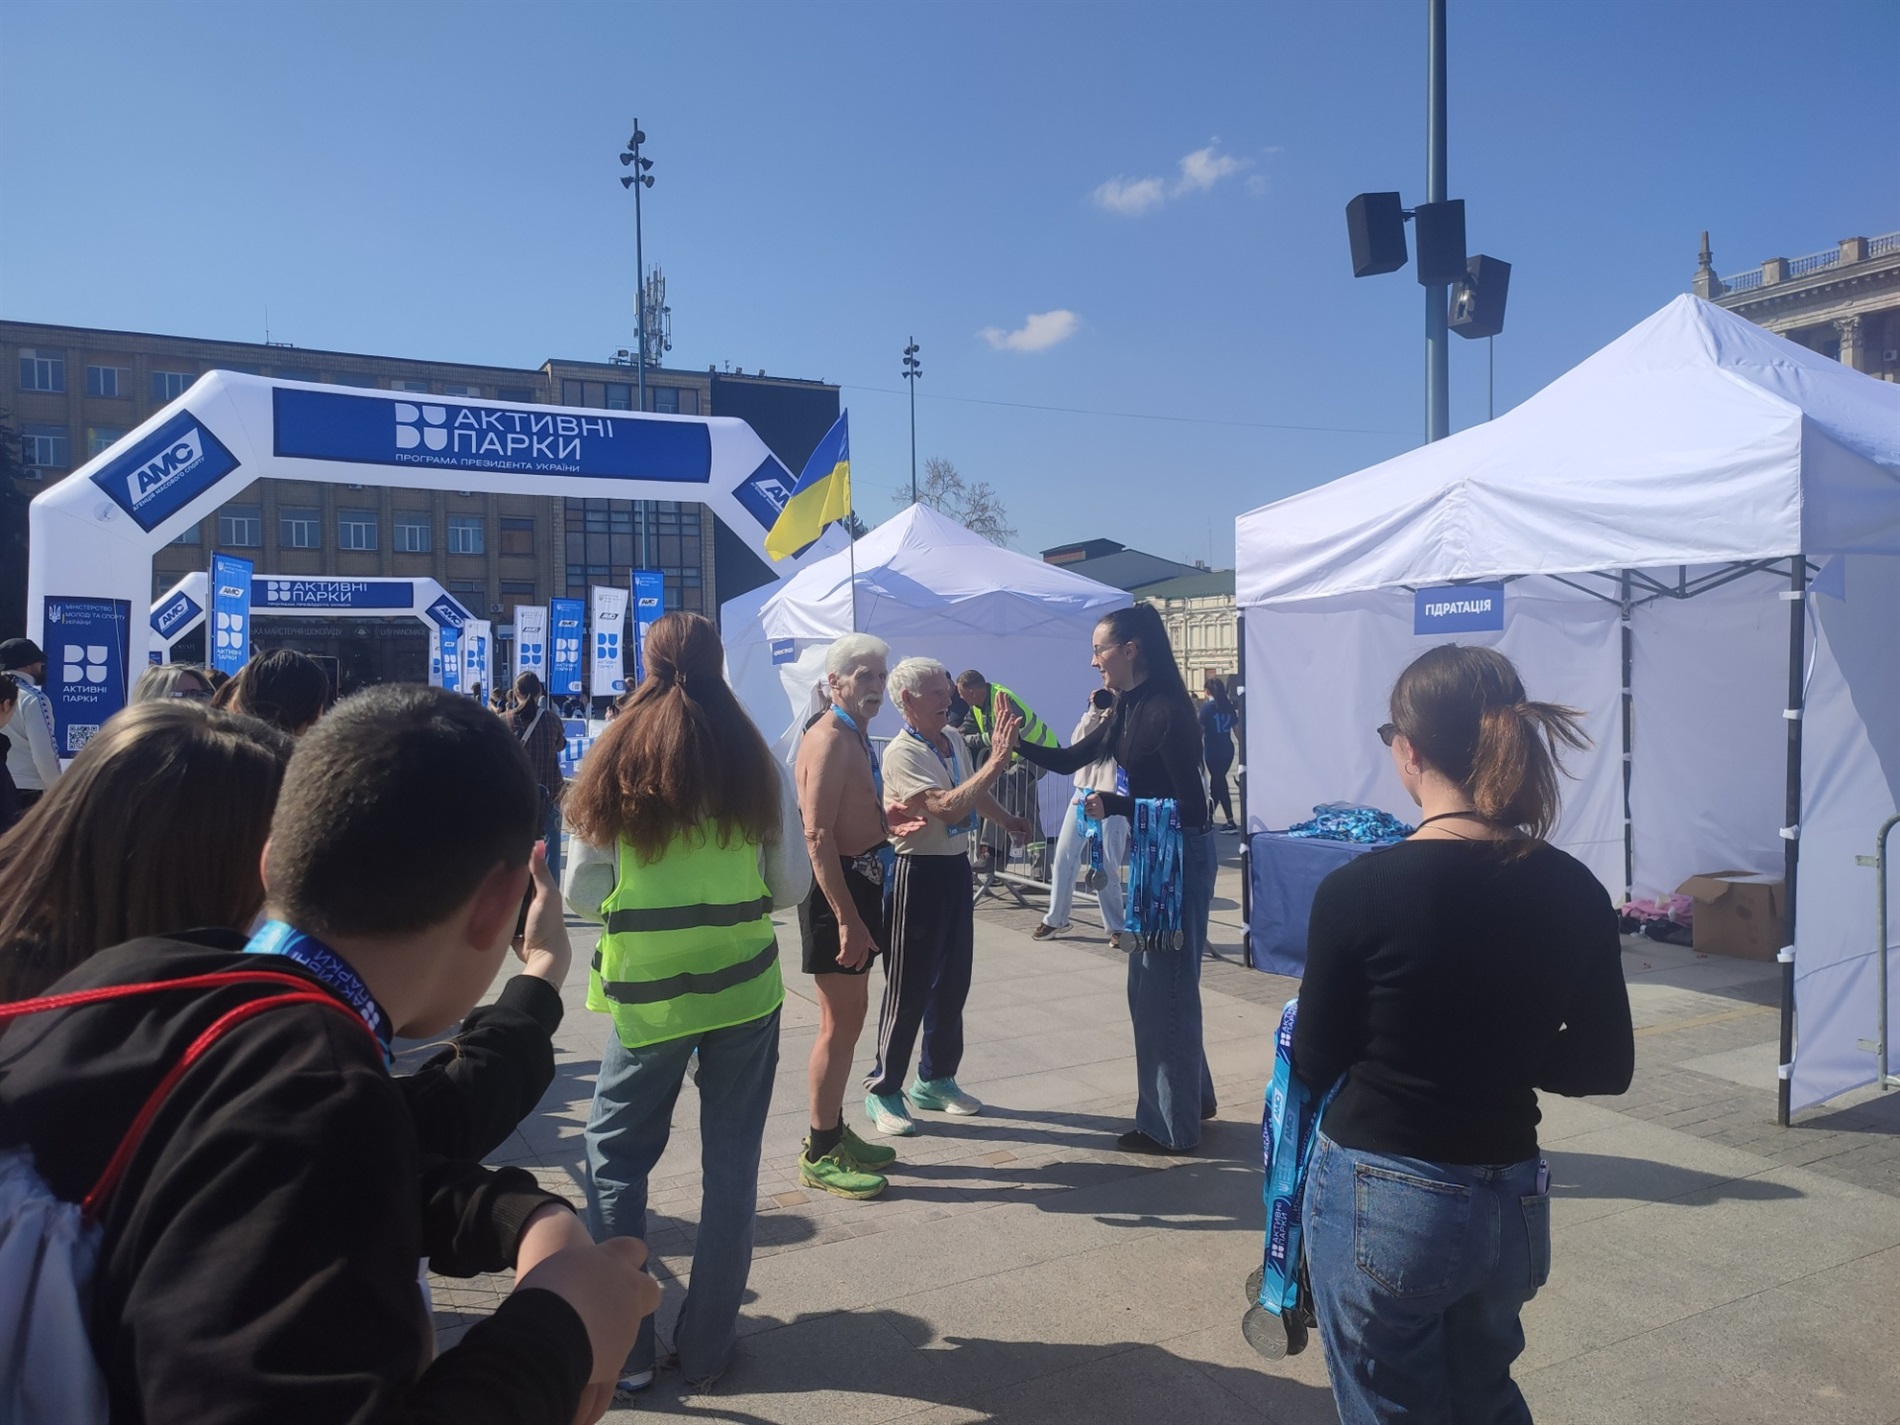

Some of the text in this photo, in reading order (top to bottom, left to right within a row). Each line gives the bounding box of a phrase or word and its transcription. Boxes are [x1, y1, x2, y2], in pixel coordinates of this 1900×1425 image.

[454, 408, 614, 438] АКТИВНІ
[454, 429, 581, 460] ПАРКИ
[395, 453, 580, 472] ПРОГРАМА ПРЕЗИДЕНТА УКРАЇНИ
[155, 472, 185, 495] МАСОВОГО
[184, 456, 205, 474] СПОРТУ
[293, 582, 367, 592] АКТИВНІ
[293, 591, 352, 602] ПАРКИ
[65, 604, 112, 612] МІНІСТЕРСТВО
[1425, 599, 1491, 617] ГІДРАТАЦІЯ
[62, 685, 107, 694] АКТИВНІ
[1213, 713, 1231, 733] 12
[314, 950, 369, 1001] ПАРКИ
[1273, 1202, 1282, 1244] АКТИВНІ
[1279, 1212, 1288, 1247] ПАРКИ
